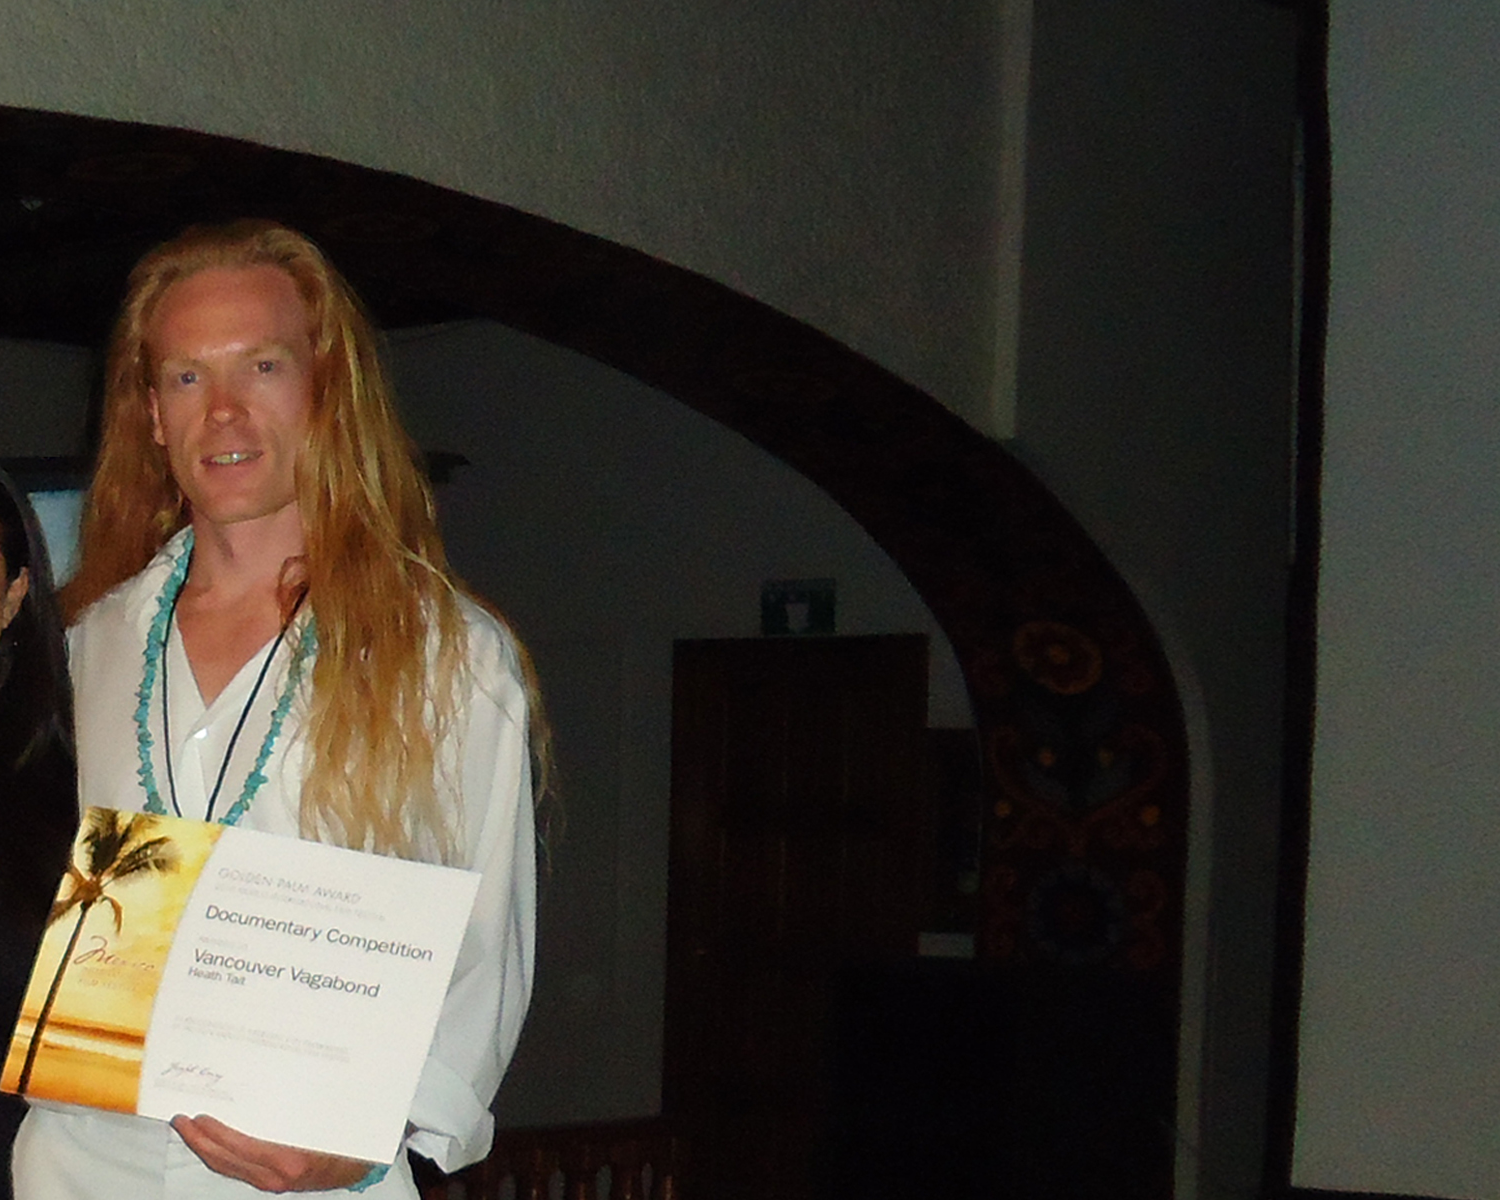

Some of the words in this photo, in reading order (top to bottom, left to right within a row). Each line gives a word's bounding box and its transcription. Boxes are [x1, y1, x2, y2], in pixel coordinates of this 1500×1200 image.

[276, 878, 309, 893] PALM
[313, 886, 362, 904] AWARD
[205, 904, 322, 942] Documentary
[326, 928, 434, 961] Competition
[188, 967, 222, 981] Heath
[192, 948, 286, 979] Vancouver
[291, 966, 381, 998] Vagabond
